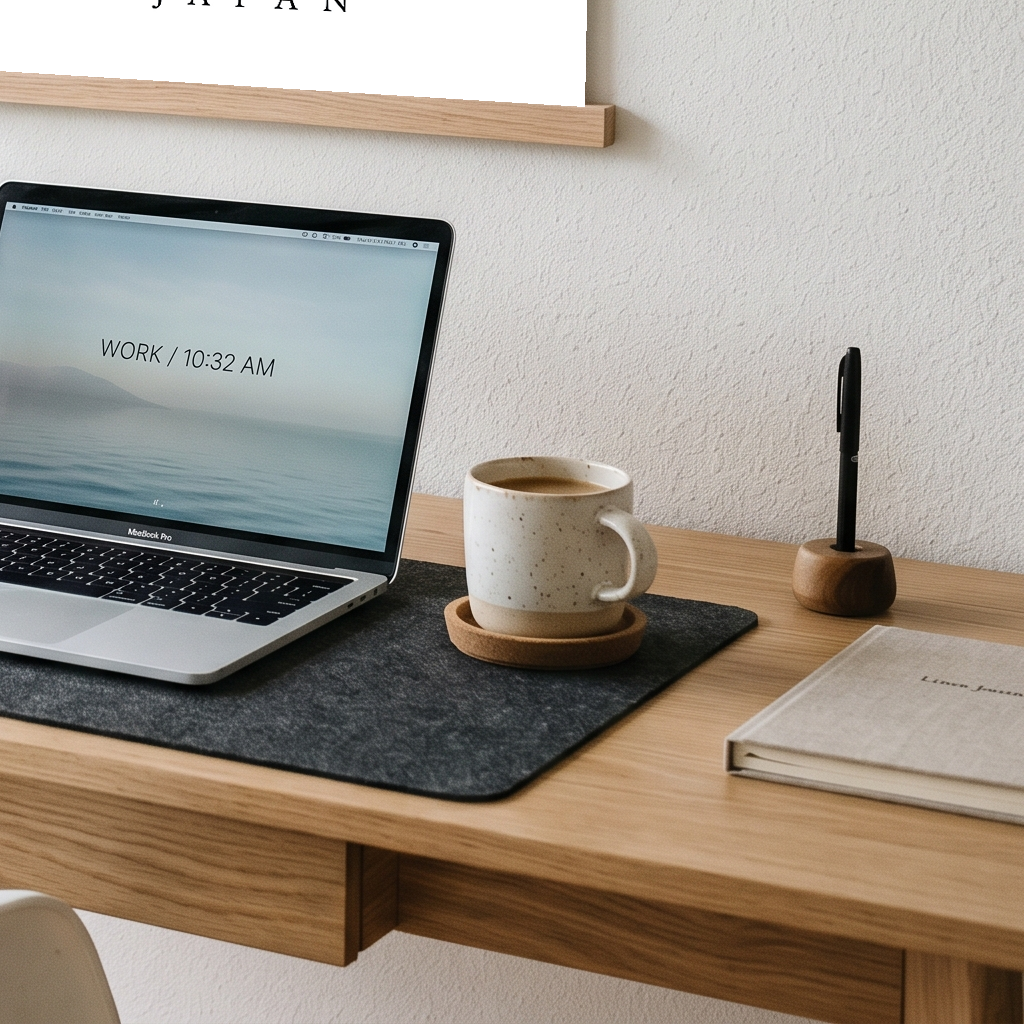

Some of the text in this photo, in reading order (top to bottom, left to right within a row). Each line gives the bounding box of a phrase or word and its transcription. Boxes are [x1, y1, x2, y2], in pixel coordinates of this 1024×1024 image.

[101, 338, 164, 364] WORK
[183, 348, 236, 373] 10:32
[239, 356, 276, 378] AM
[160, 532, 173, 542] Pro
